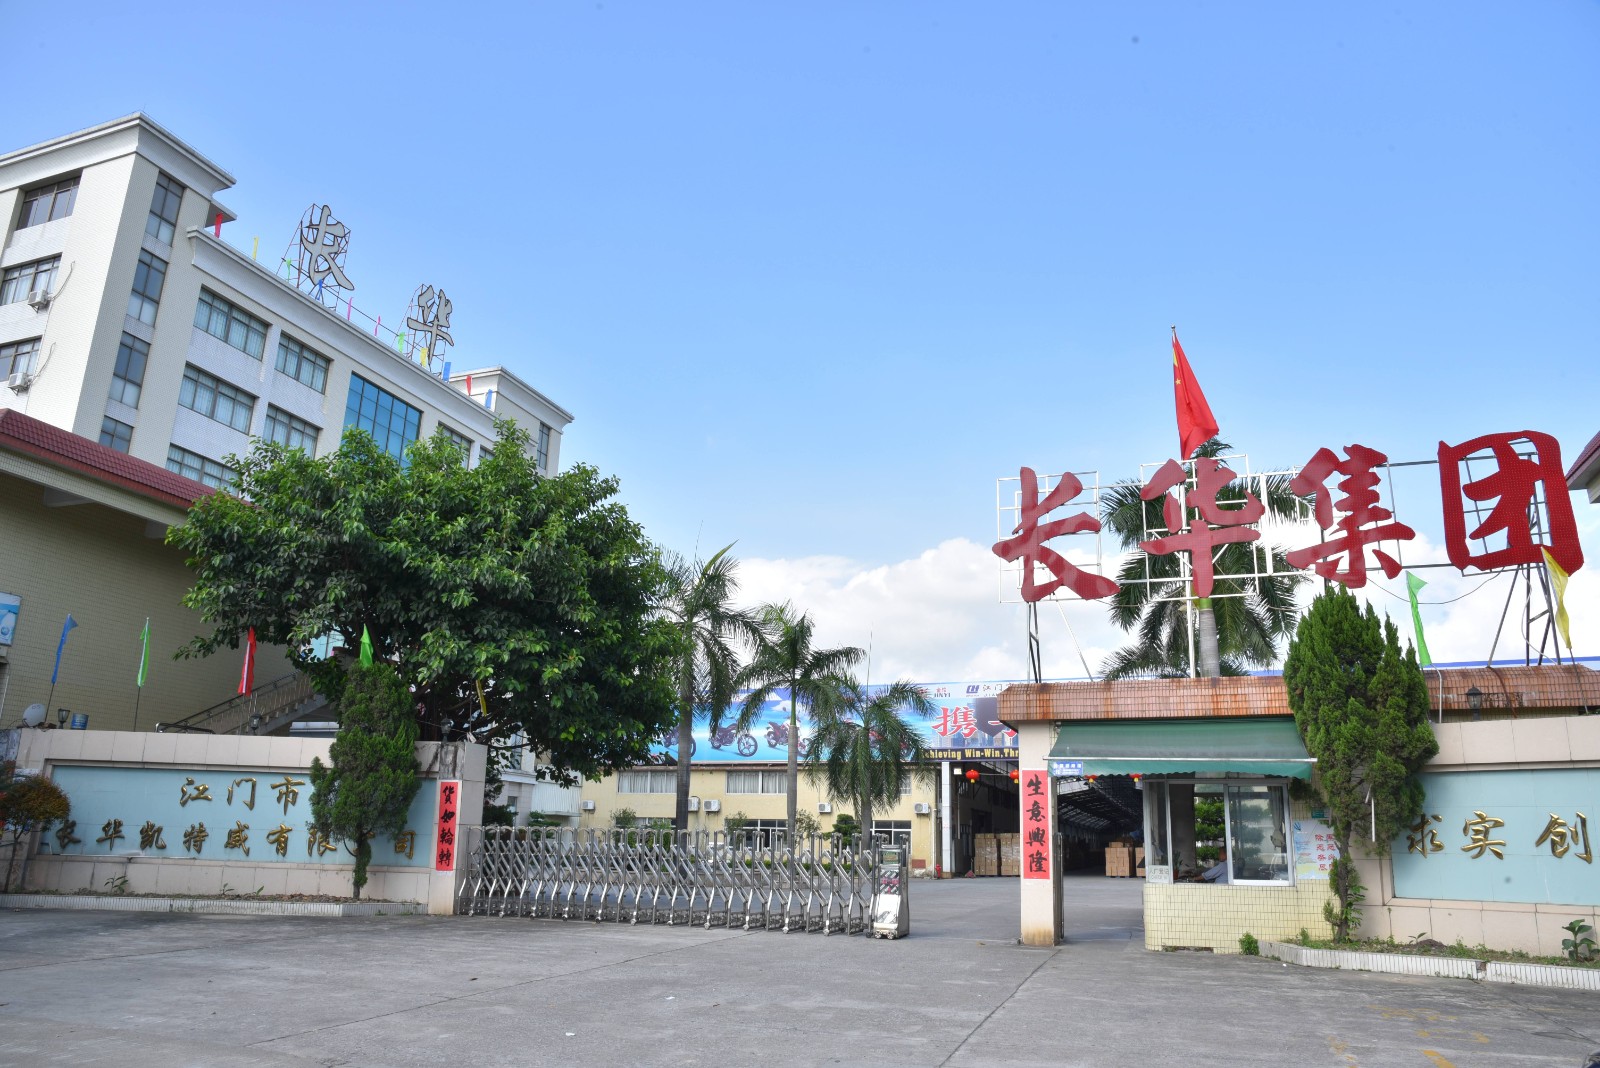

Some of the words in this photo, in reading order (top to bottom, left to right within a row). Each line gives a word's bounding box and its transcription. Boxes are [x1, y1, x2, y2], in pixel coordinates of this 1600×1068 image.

[992, 429, 1585, 602] 长华集团
[180, 776, 305, 816] 江门市
[1406, 809, 1593, 865] 求实创
